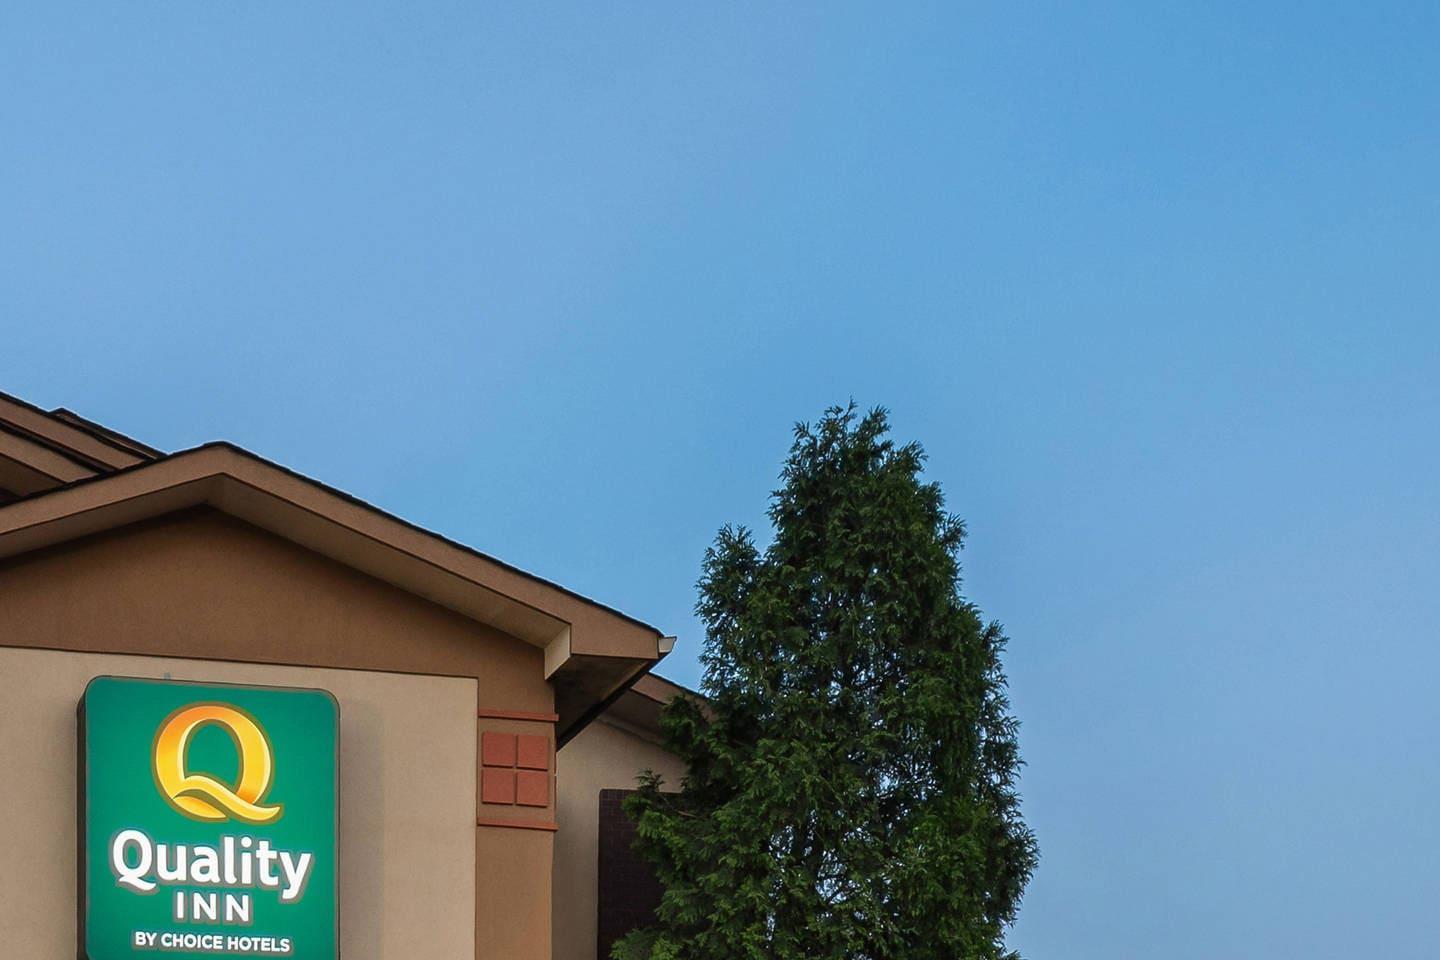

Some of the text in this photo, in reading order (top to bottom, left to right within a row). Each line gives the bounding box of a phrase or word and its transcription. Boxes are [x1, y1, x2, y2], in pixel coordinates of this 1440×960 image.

[155, 705, 281, 821] Q
[112, 829, 311, 899] Quality
[176, 891, 249, 922] INN
[135, 931, 290, 952] BY CHOICE HOTELS
